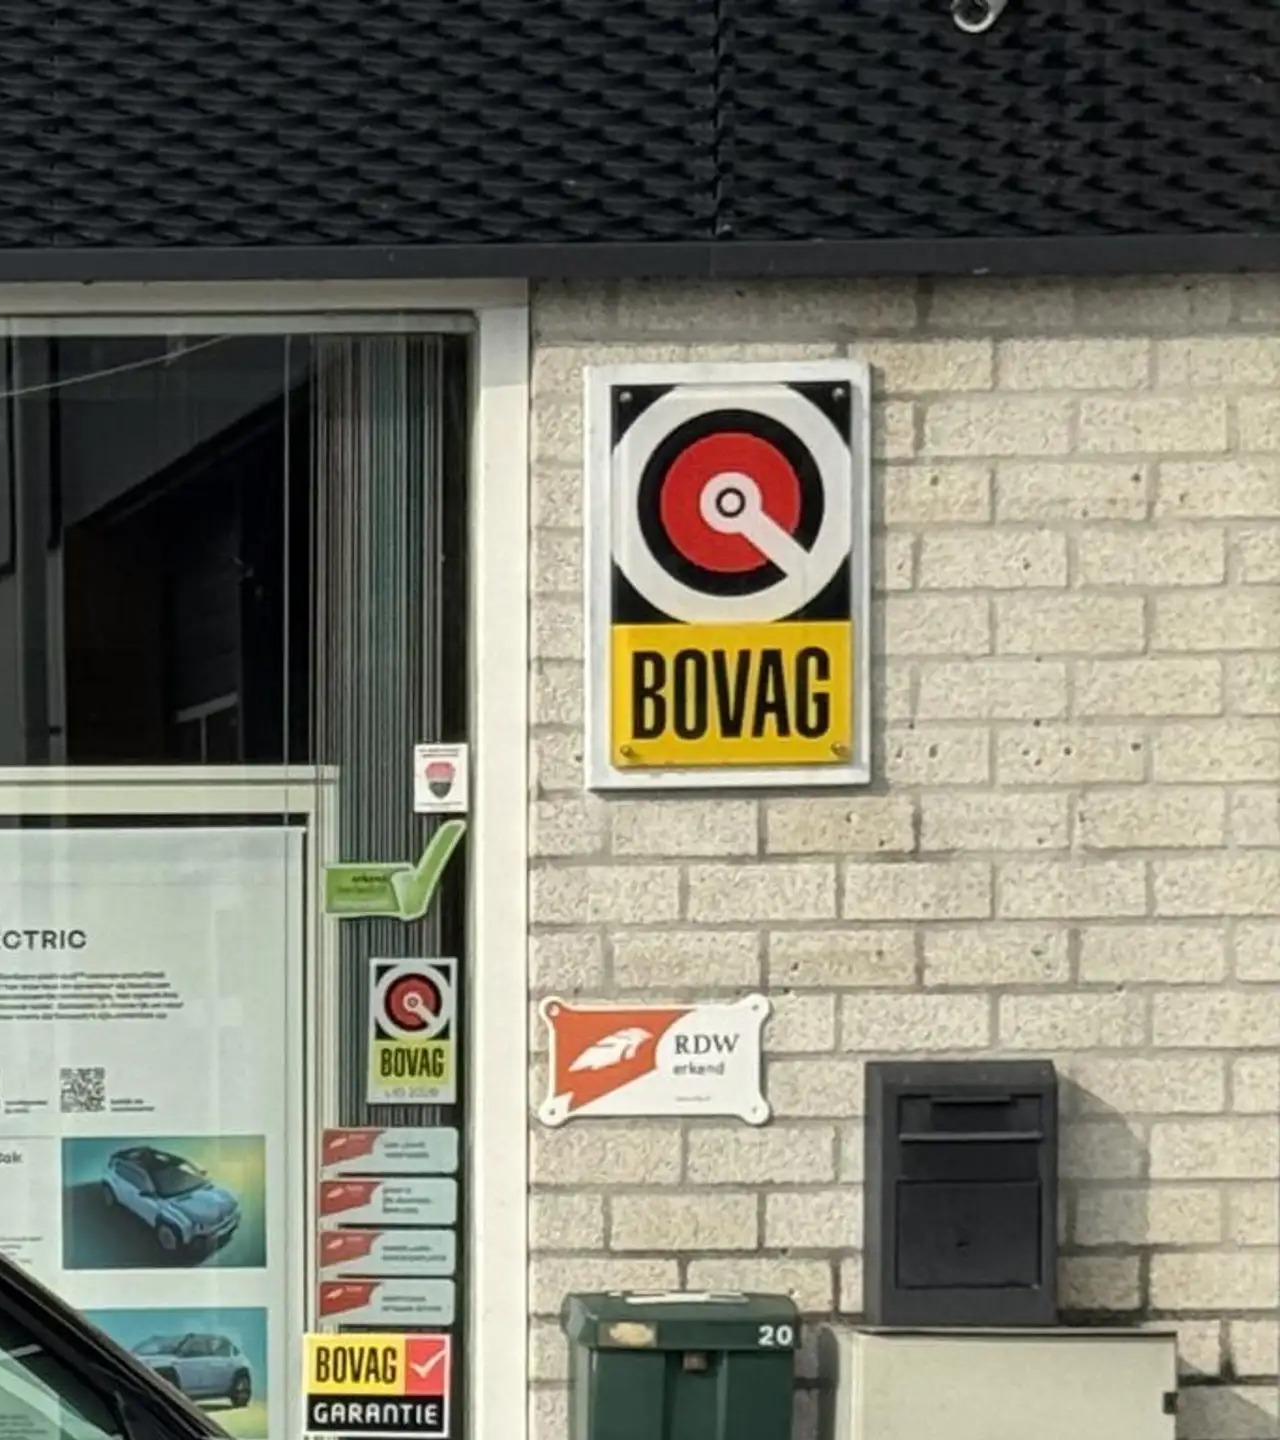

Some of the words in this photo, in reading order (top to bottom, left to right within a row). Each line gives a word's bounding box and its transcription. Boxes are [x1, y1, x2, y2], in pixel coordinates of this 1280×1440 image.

[631, 647, 830, 741] BOVAG
[675, 1033, 740, 1055] RDW
[380, 1048, 445, 1078] BOVAG
[757, 1324, 793, 1346] 20
[315, 1346, 398, 1385] BOVAG
[313, 1402, 439, 1425] GARANTIE
